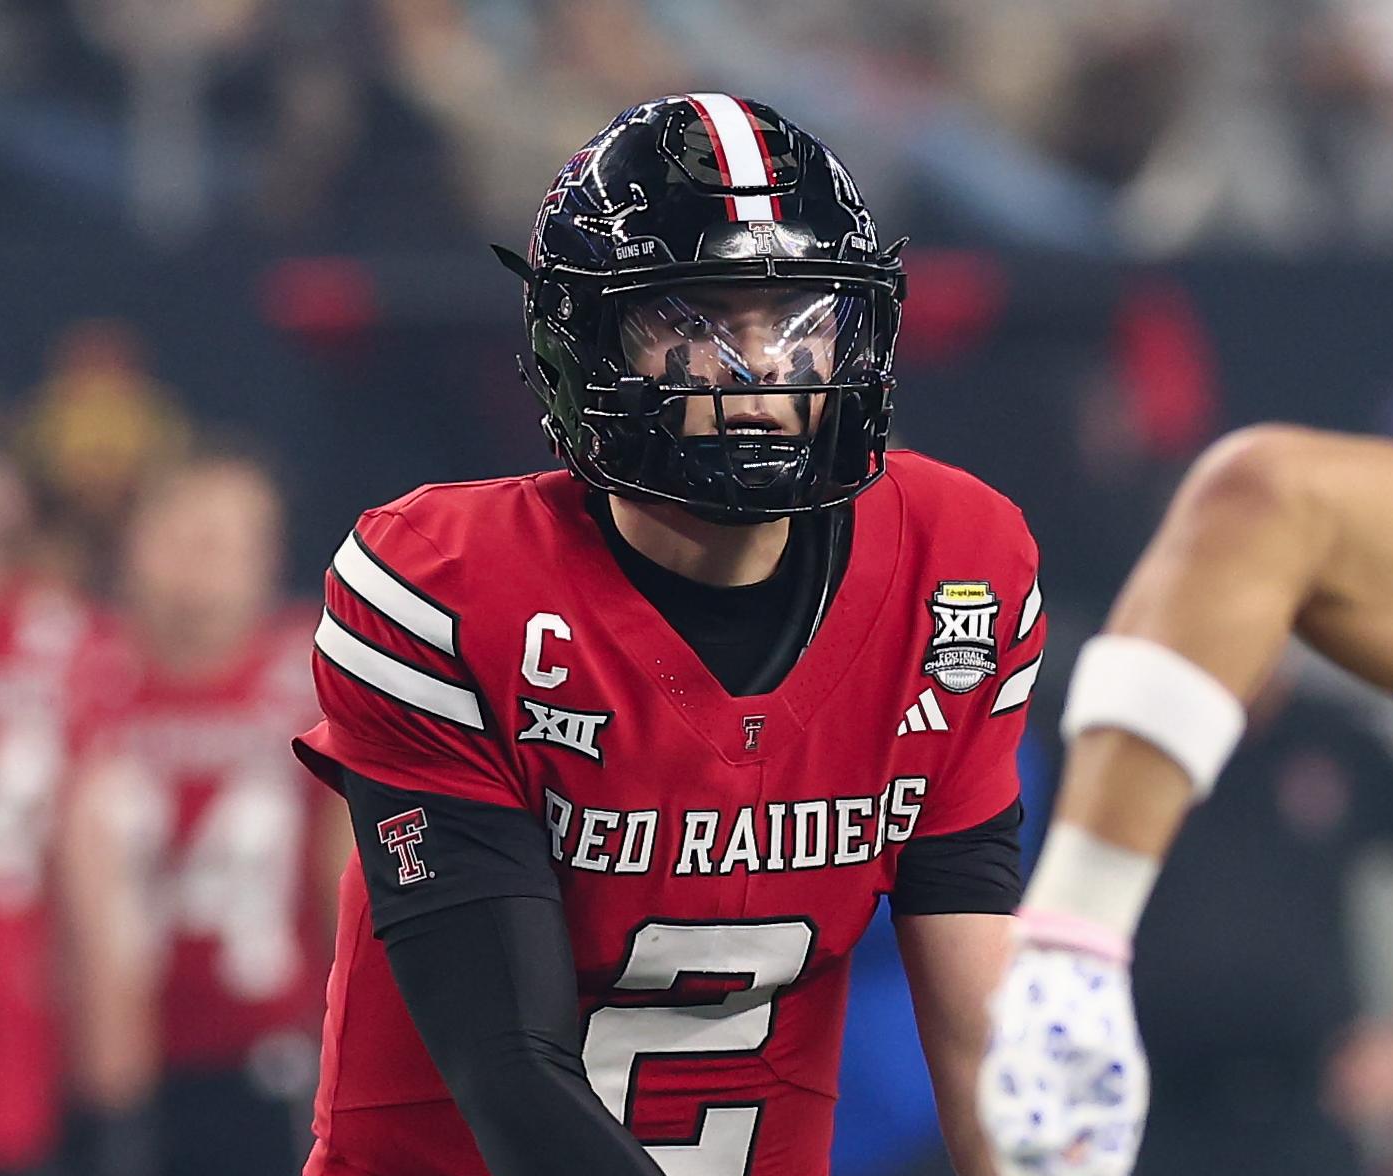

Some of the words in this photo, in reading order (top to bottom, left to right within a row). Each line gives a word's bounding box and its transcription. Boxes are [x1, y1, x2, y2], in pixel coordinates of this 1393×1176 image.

[616, 244, 639, 260] GUNS
[641, 241, 655, 255] UP
[932, 605, 998, 646] XII
[521, 612, 572, 689] C
[924, 658, 997, 671] CHAMPIONSHIP
[938, 650, 986, 661] FOOTBALL
[518, 700, 608, 760] XII
[545, 787, 658, 873] RED
